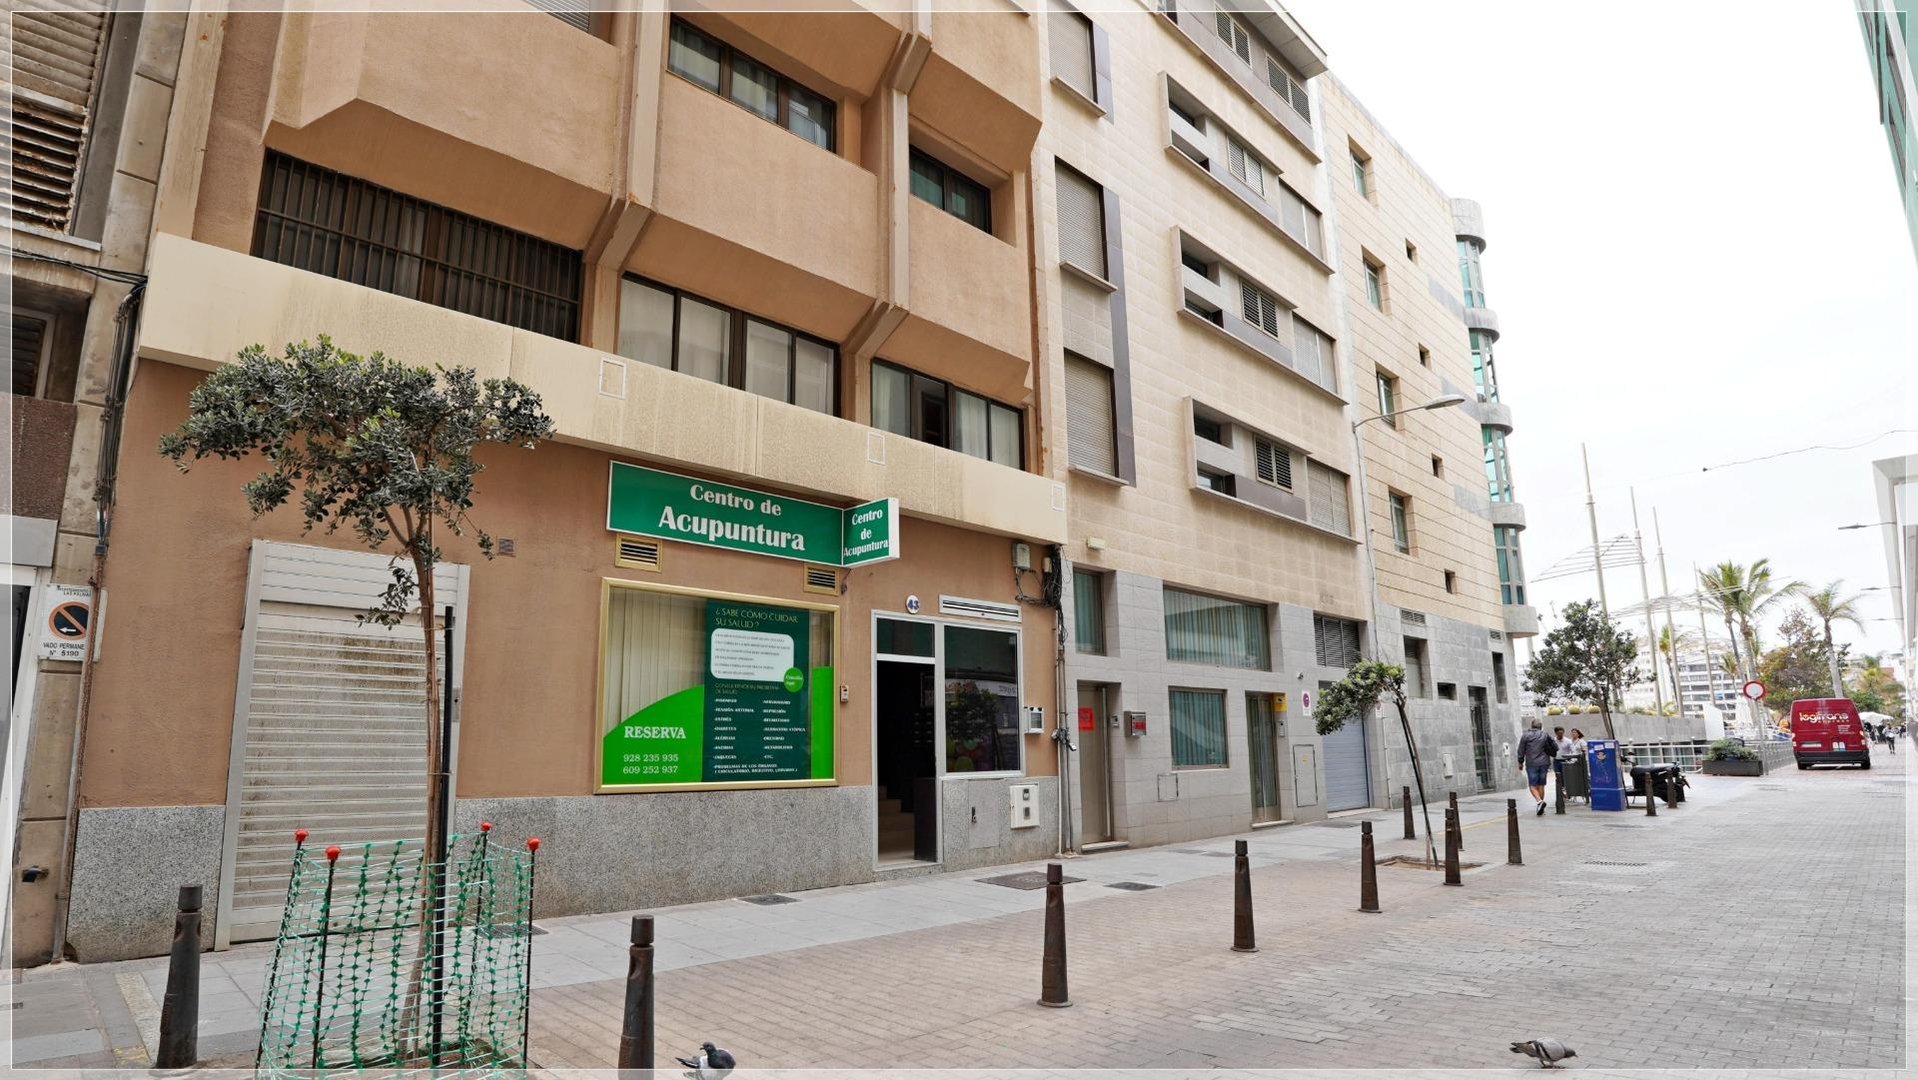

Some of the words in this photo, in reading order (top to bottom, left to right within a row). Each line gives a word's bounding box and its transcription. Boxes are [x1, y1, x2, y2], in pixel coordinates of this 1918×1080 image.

[690, 484, 754, 511] Centro
[760, 499, 782, 516] de
[851, 507, 883, 526] Centro
[658, 505, 806, 552] Acupuntura
[860, 527, 872, 541] de
[843, 539, 889, 558] Acupuntura
[908, 598, 920, 610] 43
[722, 608, 738, 618] SABE
[768, 612, 799, 623] CUIDAR
[716, 618, 726, 626] SU
[728, 620, 754, 629] SALUD
[624, 726, 686, 739] RESERVA
[623, 753, 641, 762] 928
[643, 753, 660, 762] 235
[662, 753, 679, 762] 935
[622, 766, 641, 774] 609
[642, 766, 660, 774] 252
[662, 766, 679, 774] 937
